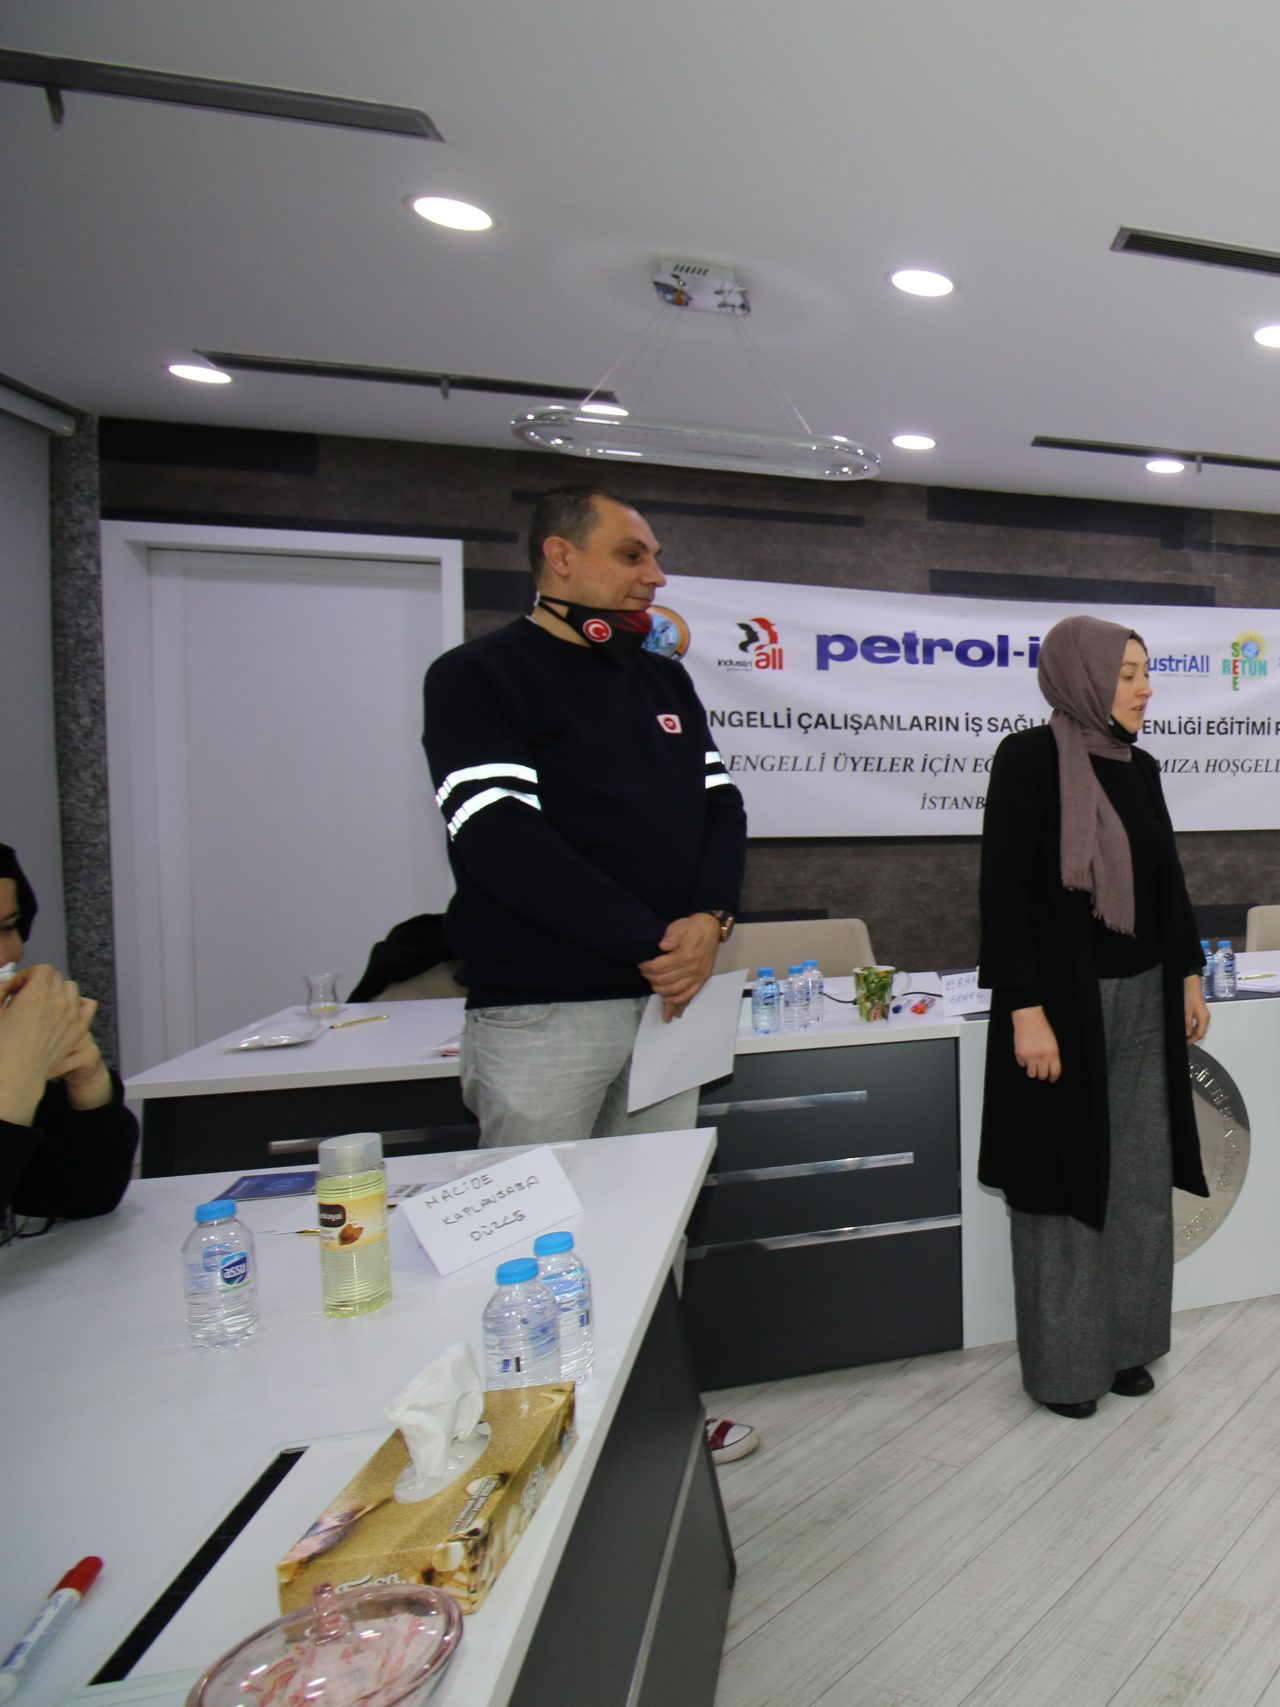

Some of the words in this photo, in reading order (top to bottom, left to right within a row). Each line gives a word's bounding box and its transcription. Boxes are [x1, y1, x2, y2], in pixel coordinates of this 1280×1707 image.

[754, 648, 784, 670] all
[816, 631, 1040, 671] petrol-i
[1148, 653, 1210, 673] ustriAll
[708, 707, 792, 729] NGELLİ
[797, 711, 960, 736] ÇALIŞANLARIN
[964, 712, 983, 737] İŞ
[1142, 716, 1202, 736] ENLİĞİ
[1206, 716, 1271, 737] EĞİTİMİ
[728, 752, 826, 773] ENGELLİ
[833, 752, 915, 774] ÜYELER
[920, 753, 967, 777] İÇİN
[972, 755, 996, 774] EĞ
[1157, 758, 1200, 774] MIZA
[920, 793, 986, 811] İSTANB
